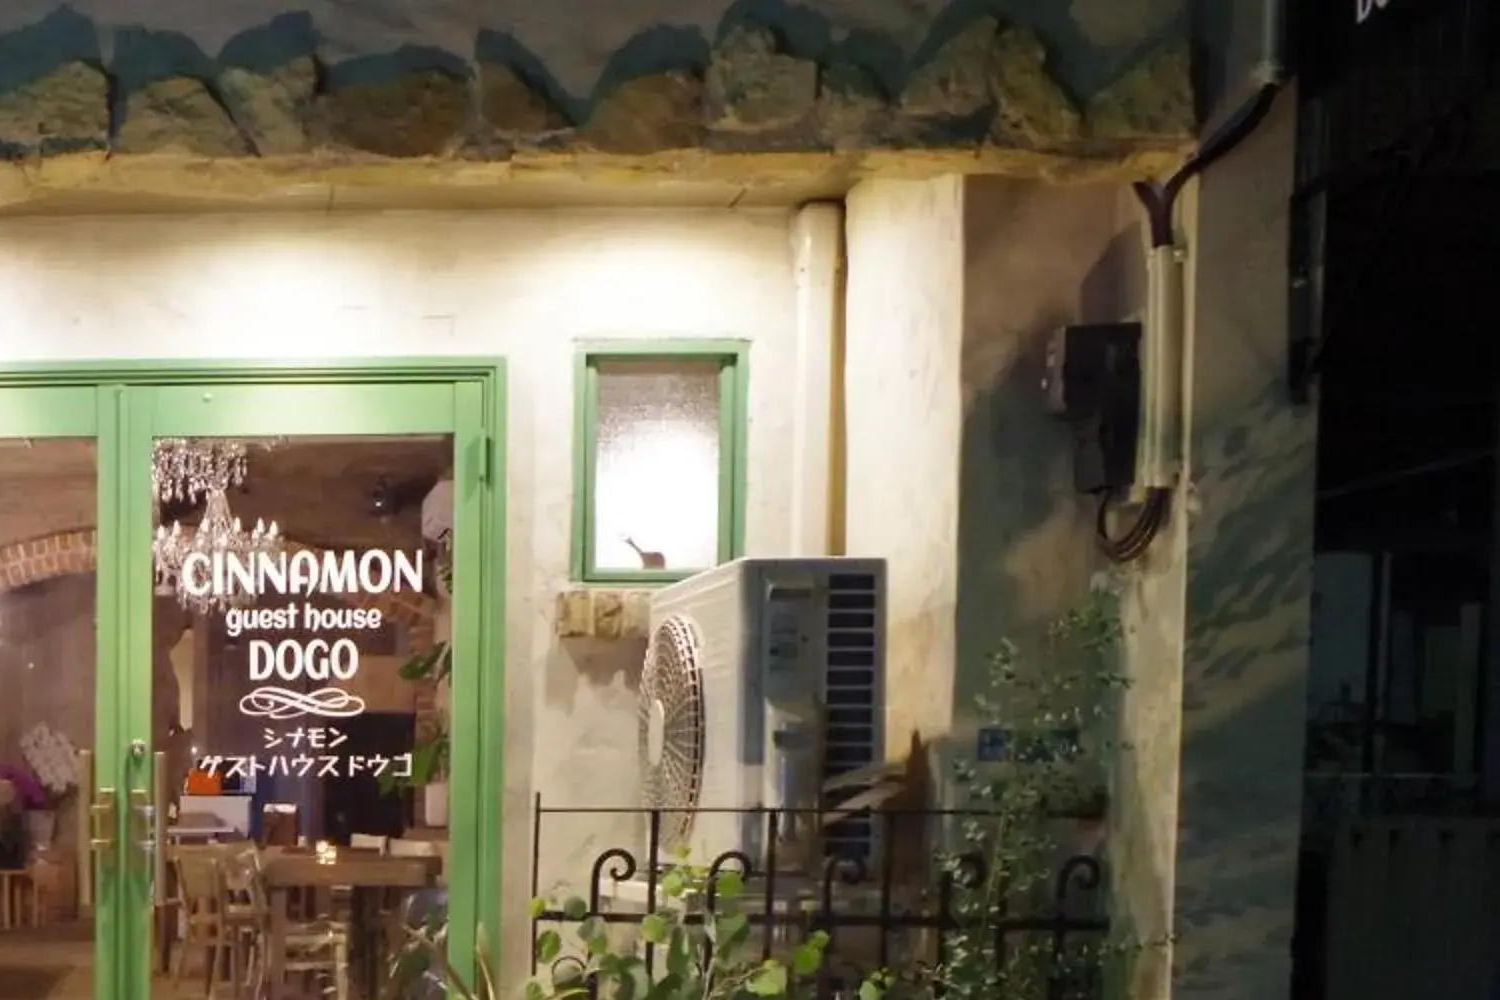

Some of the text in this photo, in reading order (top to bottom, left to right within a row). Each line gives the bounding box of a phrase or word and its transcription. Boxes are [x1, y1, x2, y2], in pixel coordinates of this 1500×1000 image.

[182, 549, 423, 598] CINNAMON
[225, 603, 382, 637] guest house
[250, 638, 359, 681] DOGO
[263, 727, 348, 749] シナモン
